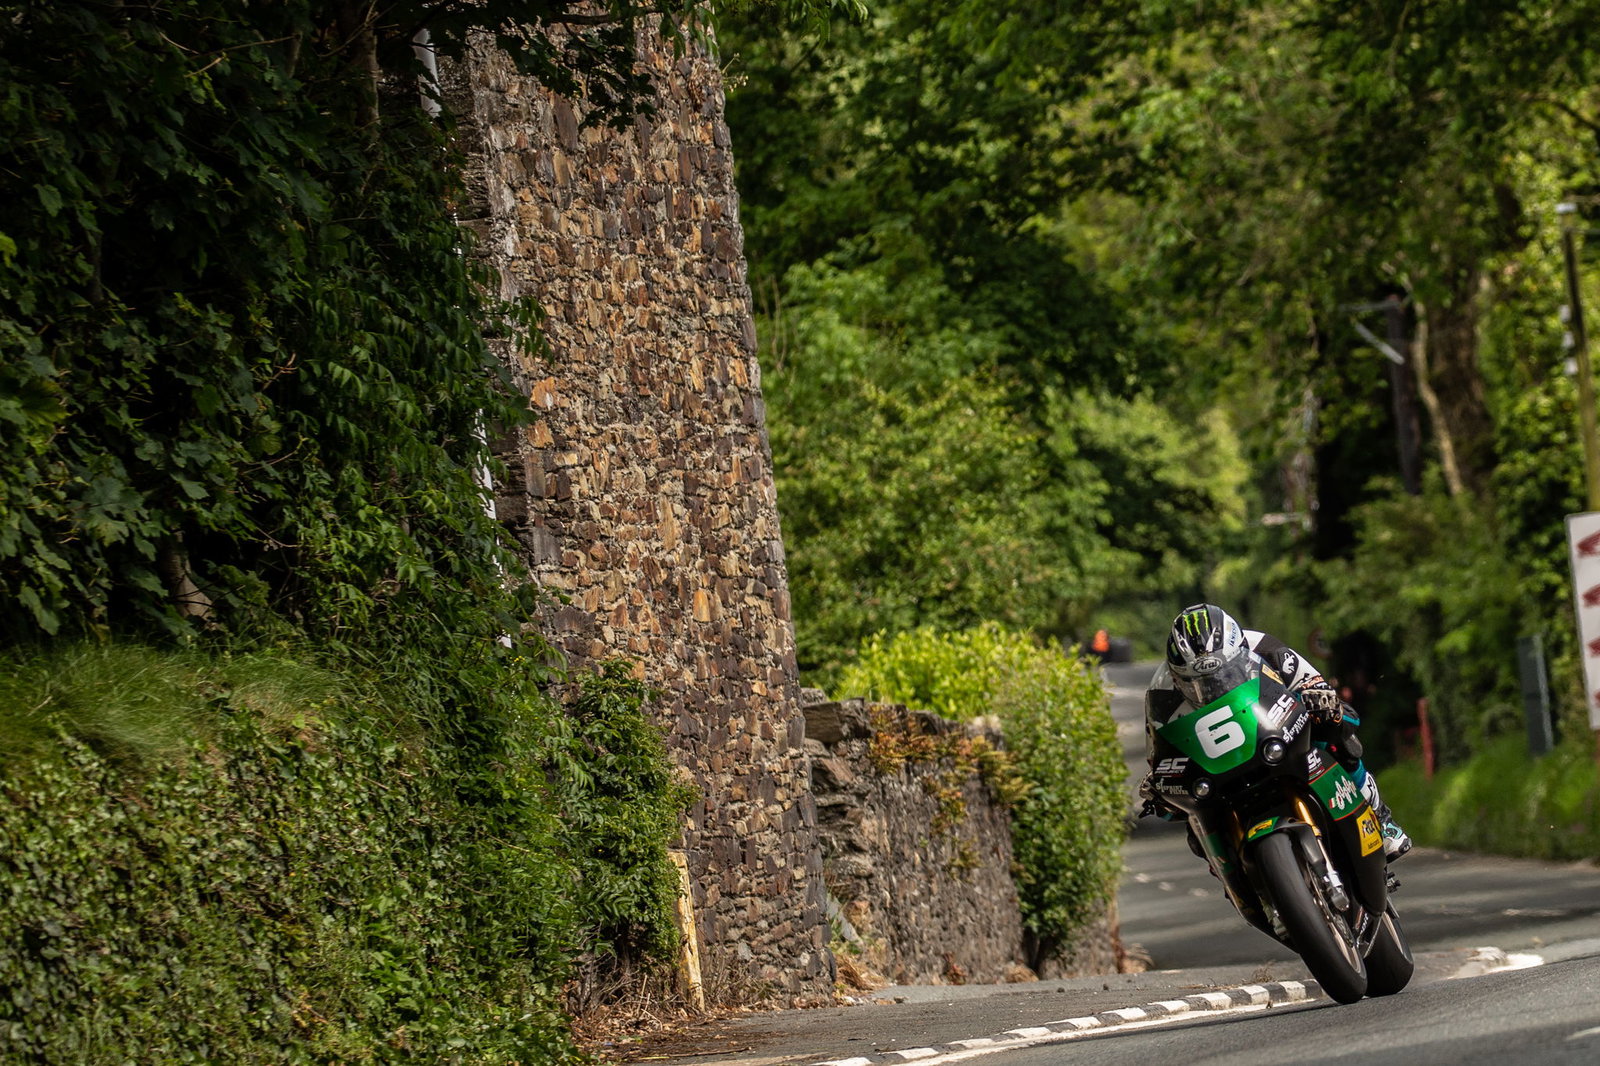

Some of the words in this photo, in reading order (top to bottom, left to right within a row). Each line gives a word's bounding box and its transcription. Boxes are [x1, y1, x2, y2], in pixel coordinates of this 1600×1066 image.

[1197, 658, 1218, 671] Arai
[1267, 694, 1293, 722] SC
[1195, 705, 1245, 759] 6
[1156, 757, 1189, 771] SC
[1307, 748, 1321, 770] SC
